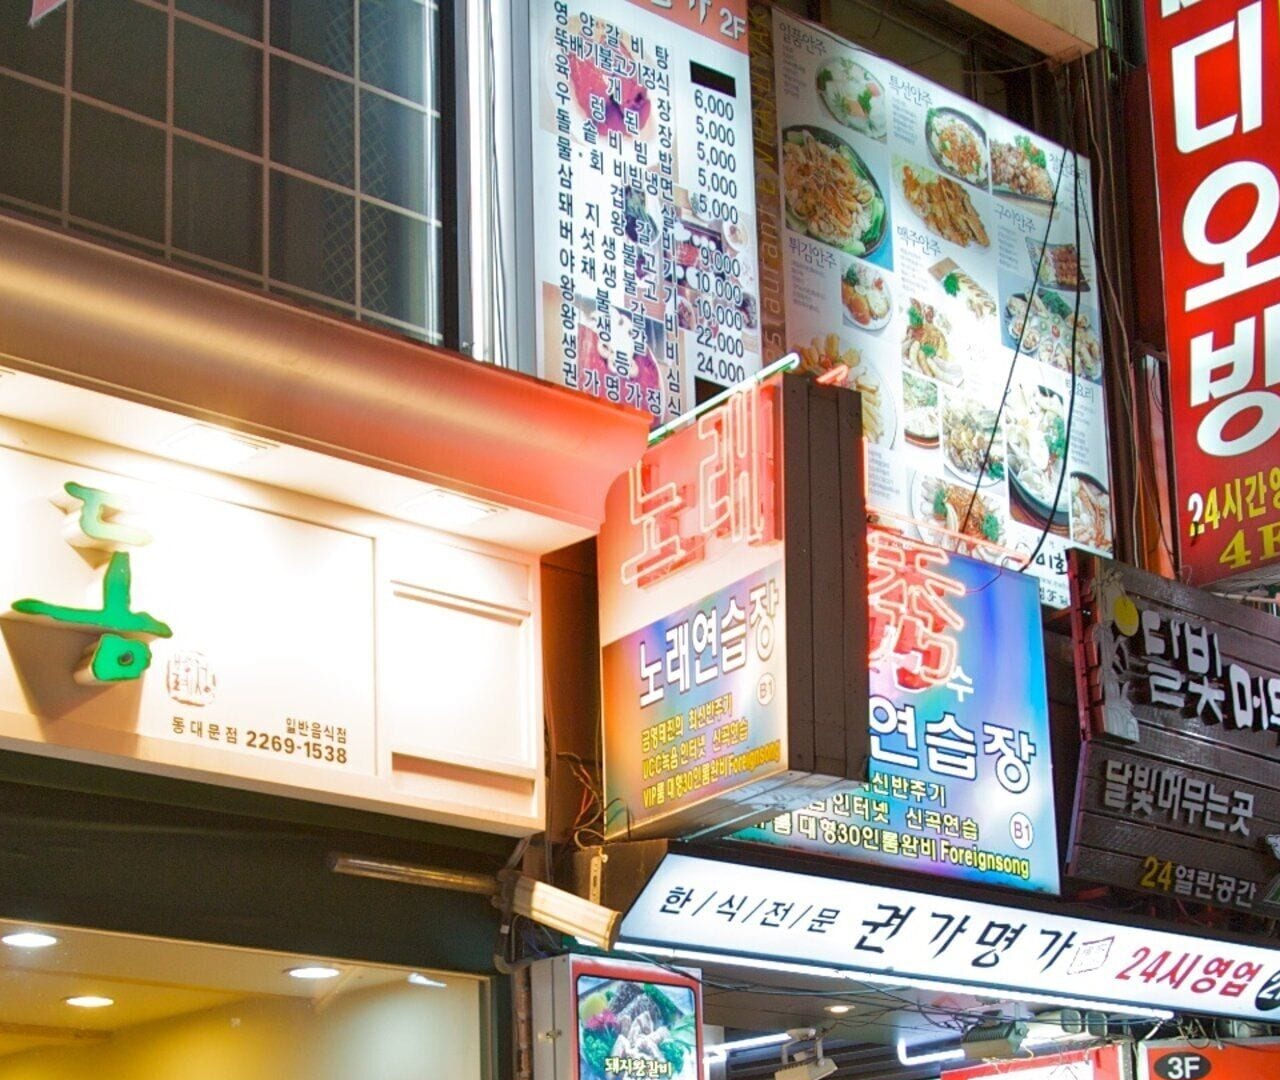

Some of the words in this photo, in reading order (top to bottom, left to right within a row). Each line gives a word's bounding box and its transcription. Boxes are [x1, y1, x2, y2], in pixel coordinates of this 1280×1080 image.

[719, 8, 747, 41] 2F
[778, 22, 828, 57] 일품안주
[694, 88, 734, 122] 6,000
[889, 74, 933, 107] 특선안주
[695, 115, 736, 149] 5,000
[696, 141, 737, 174] 5,000
[697, 167, 738, 200] 5,000
[698, 193, 739, 225] 5,000
[995, 204, 1036, 232] 구이안주
[789, 236, 837, 268] 튀김안주
[897, 225, 941, 256] 맥주안주
[699, 243, 741, 278] 9,000
[694, 268, 743, 305] 10,000
[695, 297, 743, 331] 10,000
[696, 324, 745, 358] 22,000
[697, 352, 746, 384] 24,000
[620, 392, 766, 588] 노래
[638, 582, 780, 710] 노래연습장
[687, 691, 733, 732] 최신반주기
[172, 716, 238, 745] 동대문점
[246, 730, 348, 764] 2269-1538
[286, 717, 347, 745] 일반음식점
[680, 733, 706, 765] 인터넷
[712, 717, 749, 753] 신곡연습
[905, 806, 979, 841] 신곡연습
[1013, 818, 1033, 842] B1
[940, 839, 1031, 880] Foreignsong
[604, 1056, 673, 1078] 돼지왕갈비
[1166, 1054, 1202, 1080] 3F
